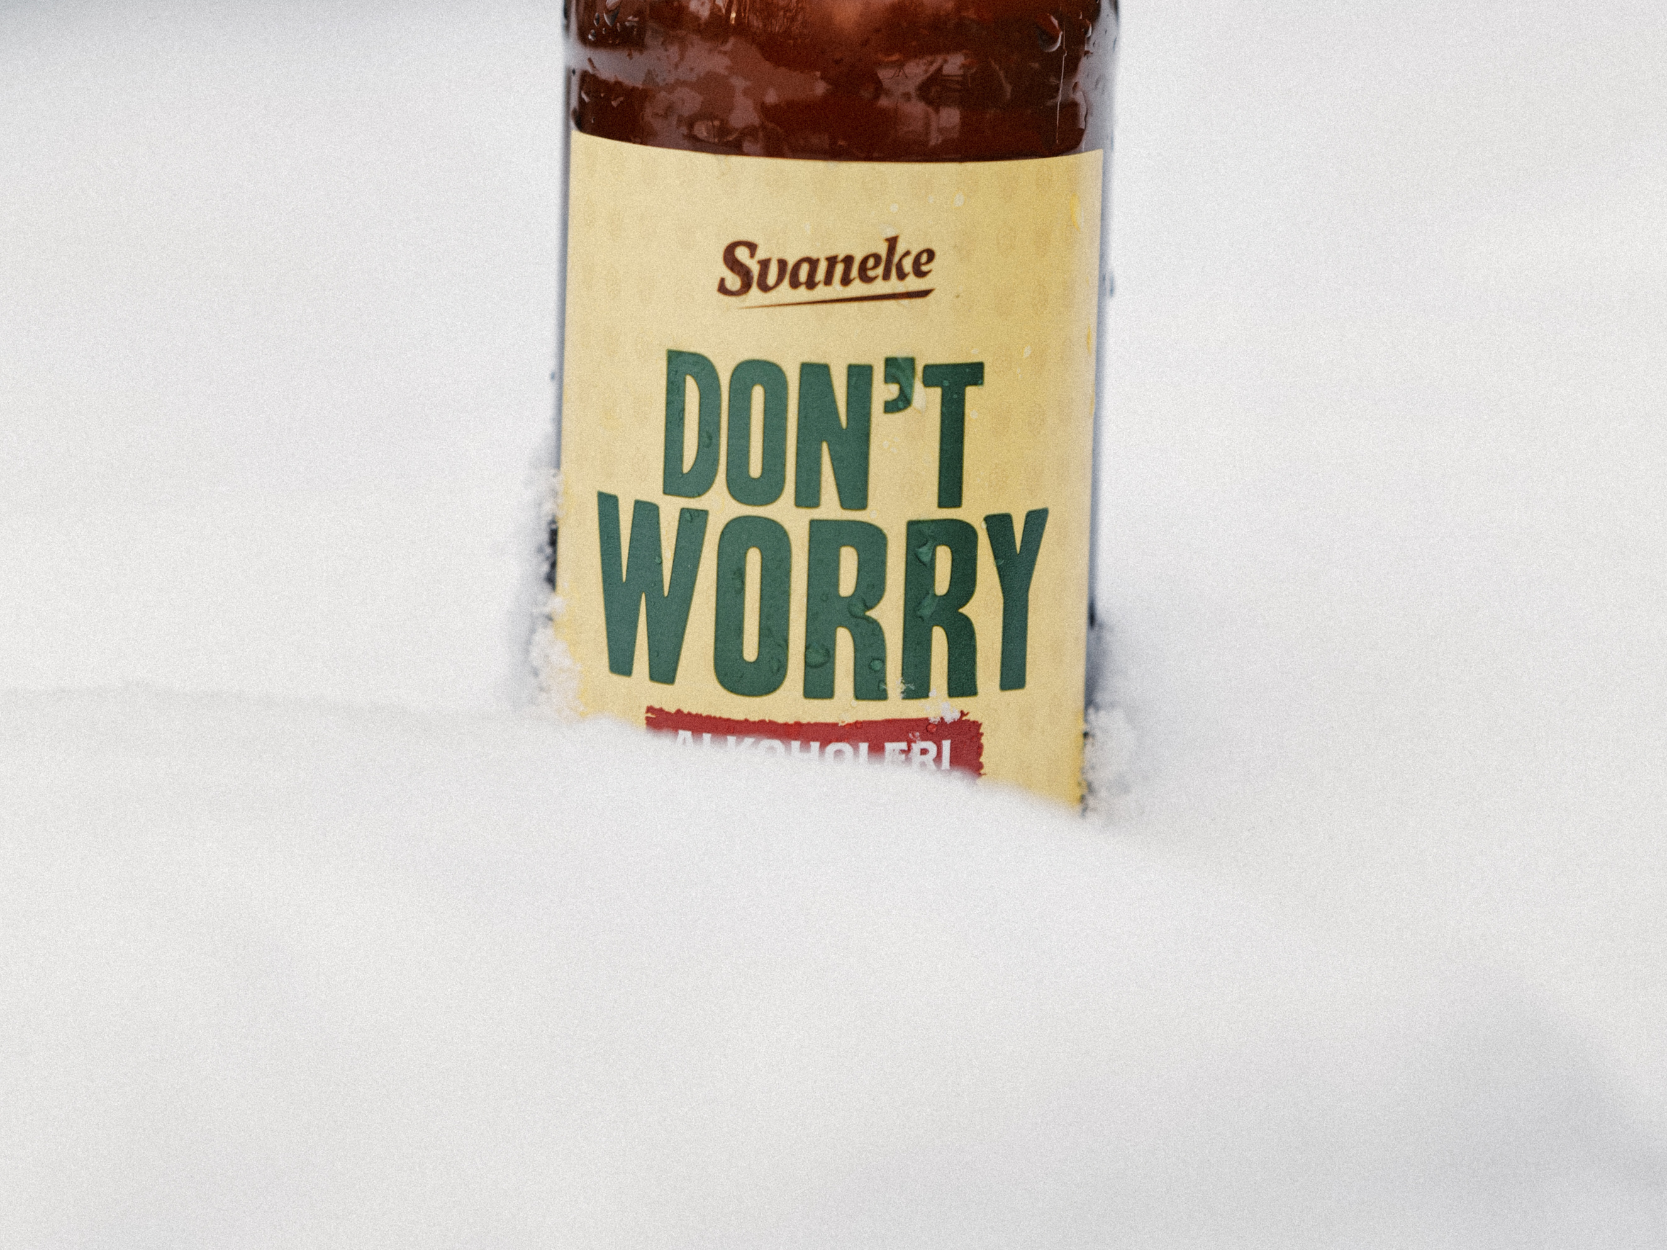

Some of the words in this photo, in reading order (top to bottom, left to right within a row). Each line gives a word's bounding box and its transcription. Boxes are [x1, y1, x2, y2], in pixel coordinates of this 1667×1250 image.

[716, 235, 936, 297] Svaneke
[662, 349, 985, 511] DON'T
[597, 491, 1050, 701] WORRY
